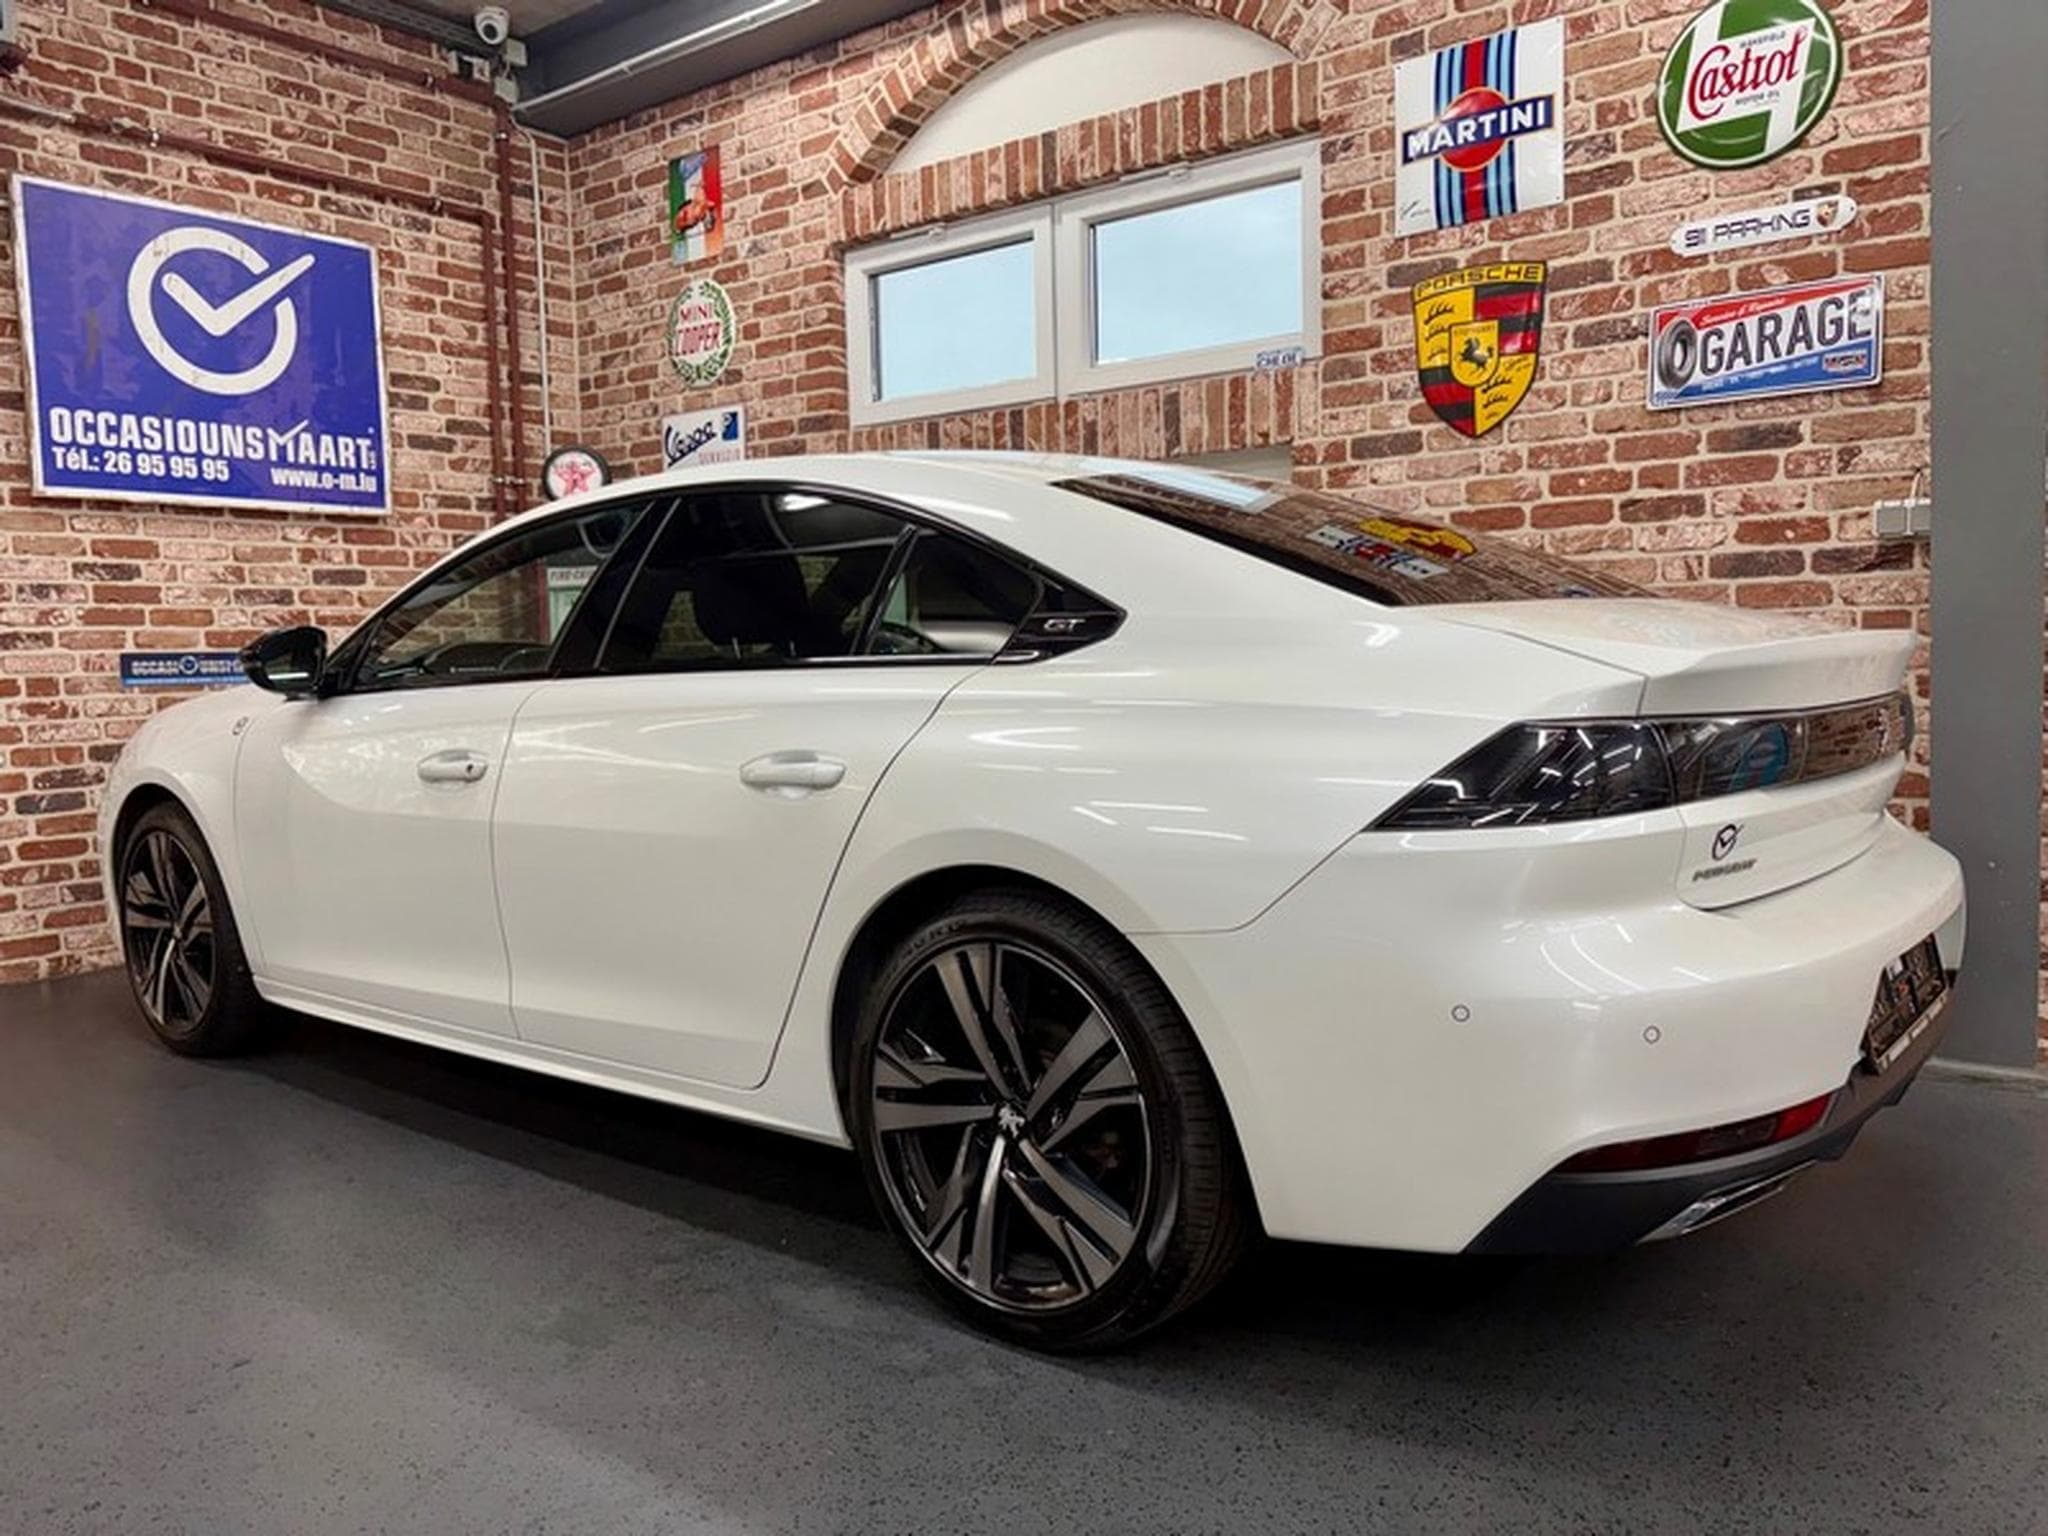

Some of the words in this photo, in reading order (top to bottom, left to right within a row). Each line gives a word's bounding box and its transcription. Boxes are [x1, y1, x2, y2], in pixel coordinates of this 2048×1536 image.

[1688, 26, 1807, 120] Castrol
[1407, 101, 1546, 158] MARTINI
[1713, 209, 1810, 242] PARKING
[1417, 265, 1540, 298] PORSCHE
[1700, 289, 1873, 376] GARAGE
[665, 421, 717, 467] Vespa
[103, 450, 132, 475] 26
[136, 452, 166, 477] 95
[169, 455, 198, 480] 95
[202, 458, 230, 482] 95
[270, 467, 377, 493] www.o-m.lu
[1043, 619, 1086, 632] GT
